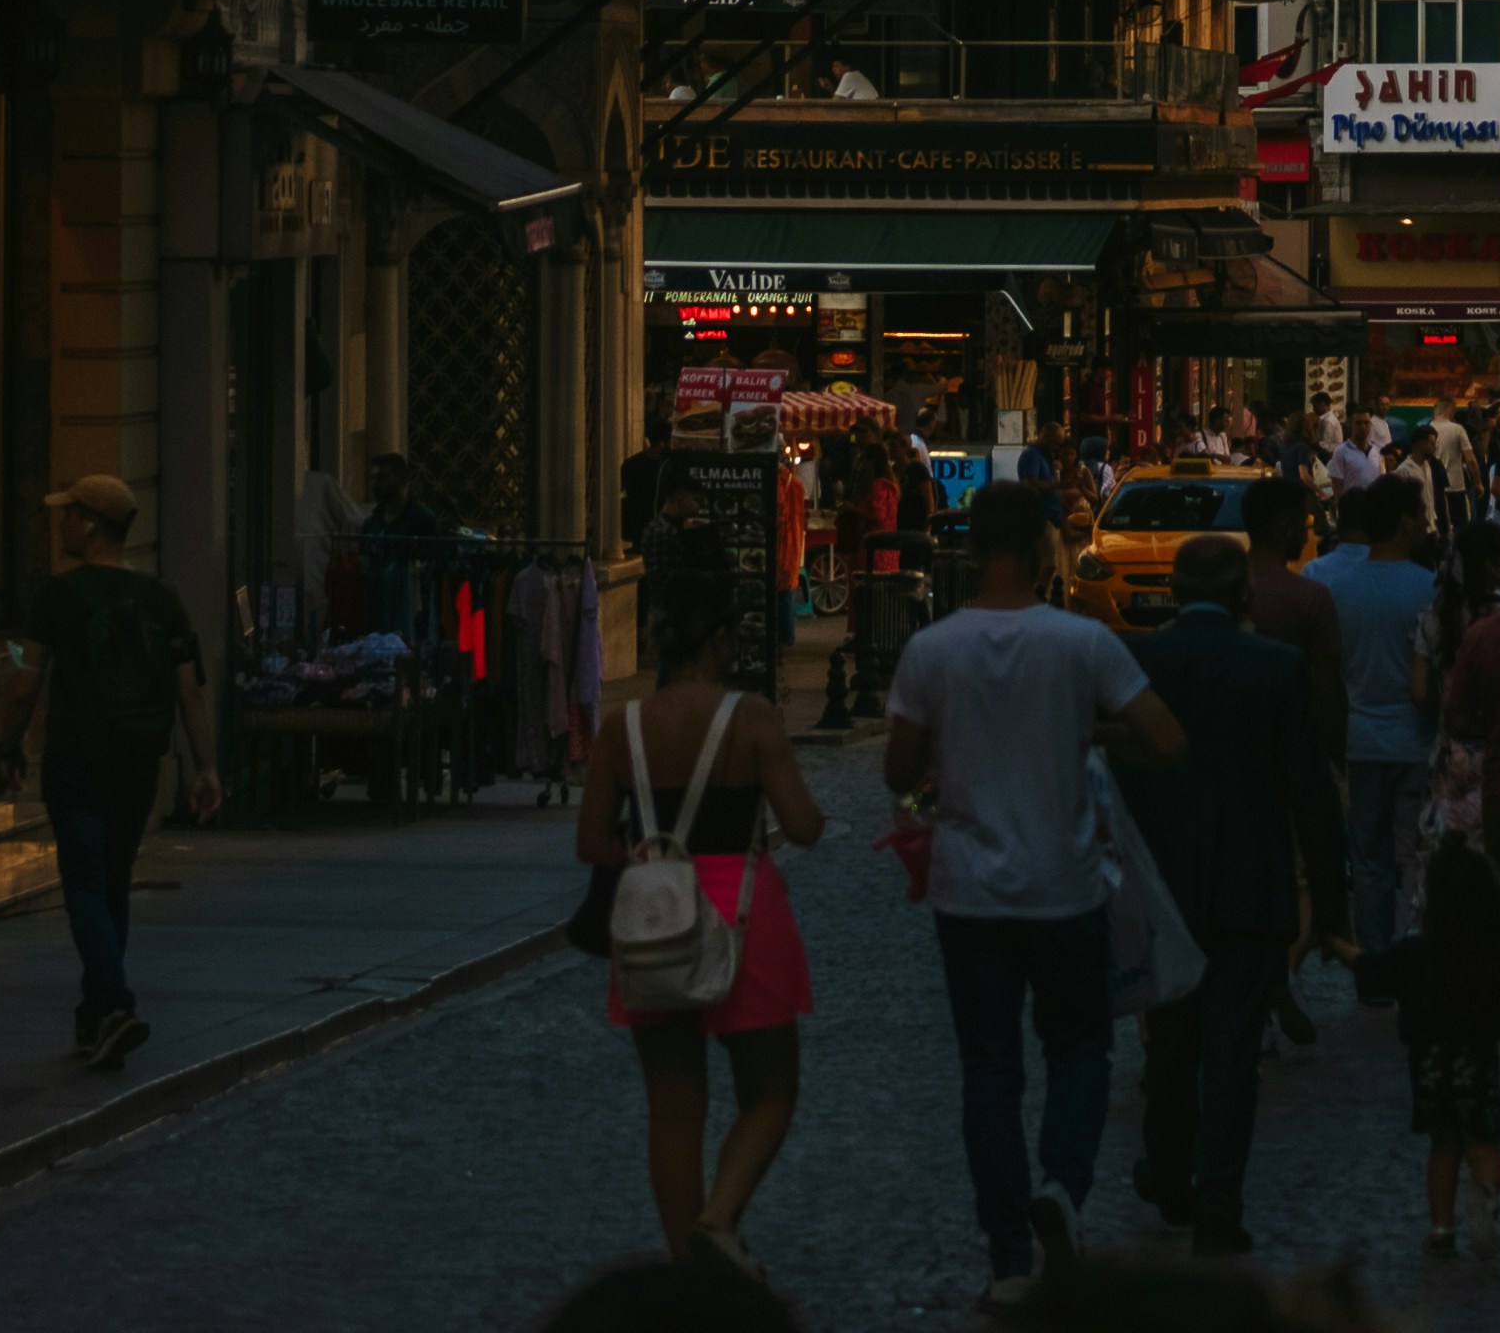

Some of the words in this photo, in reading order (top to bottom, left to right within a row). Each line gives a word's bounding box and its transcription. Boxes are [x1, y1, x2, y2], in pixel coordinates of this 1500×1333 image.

[1332, 114, 1385, 149] Pipo
[1391, 112, 1499, 149] Dünyası
[708, 269, 786, 290] VALİDE
[665, 291, 738, 304] POMEGRANATE
[747, 291, 788, 304] ORANGE
[1395, 306, 1436, 316] KOSKA
[678, 388, 716, 399] EKMEK
[730, 391, 769, 401] EKMEK
